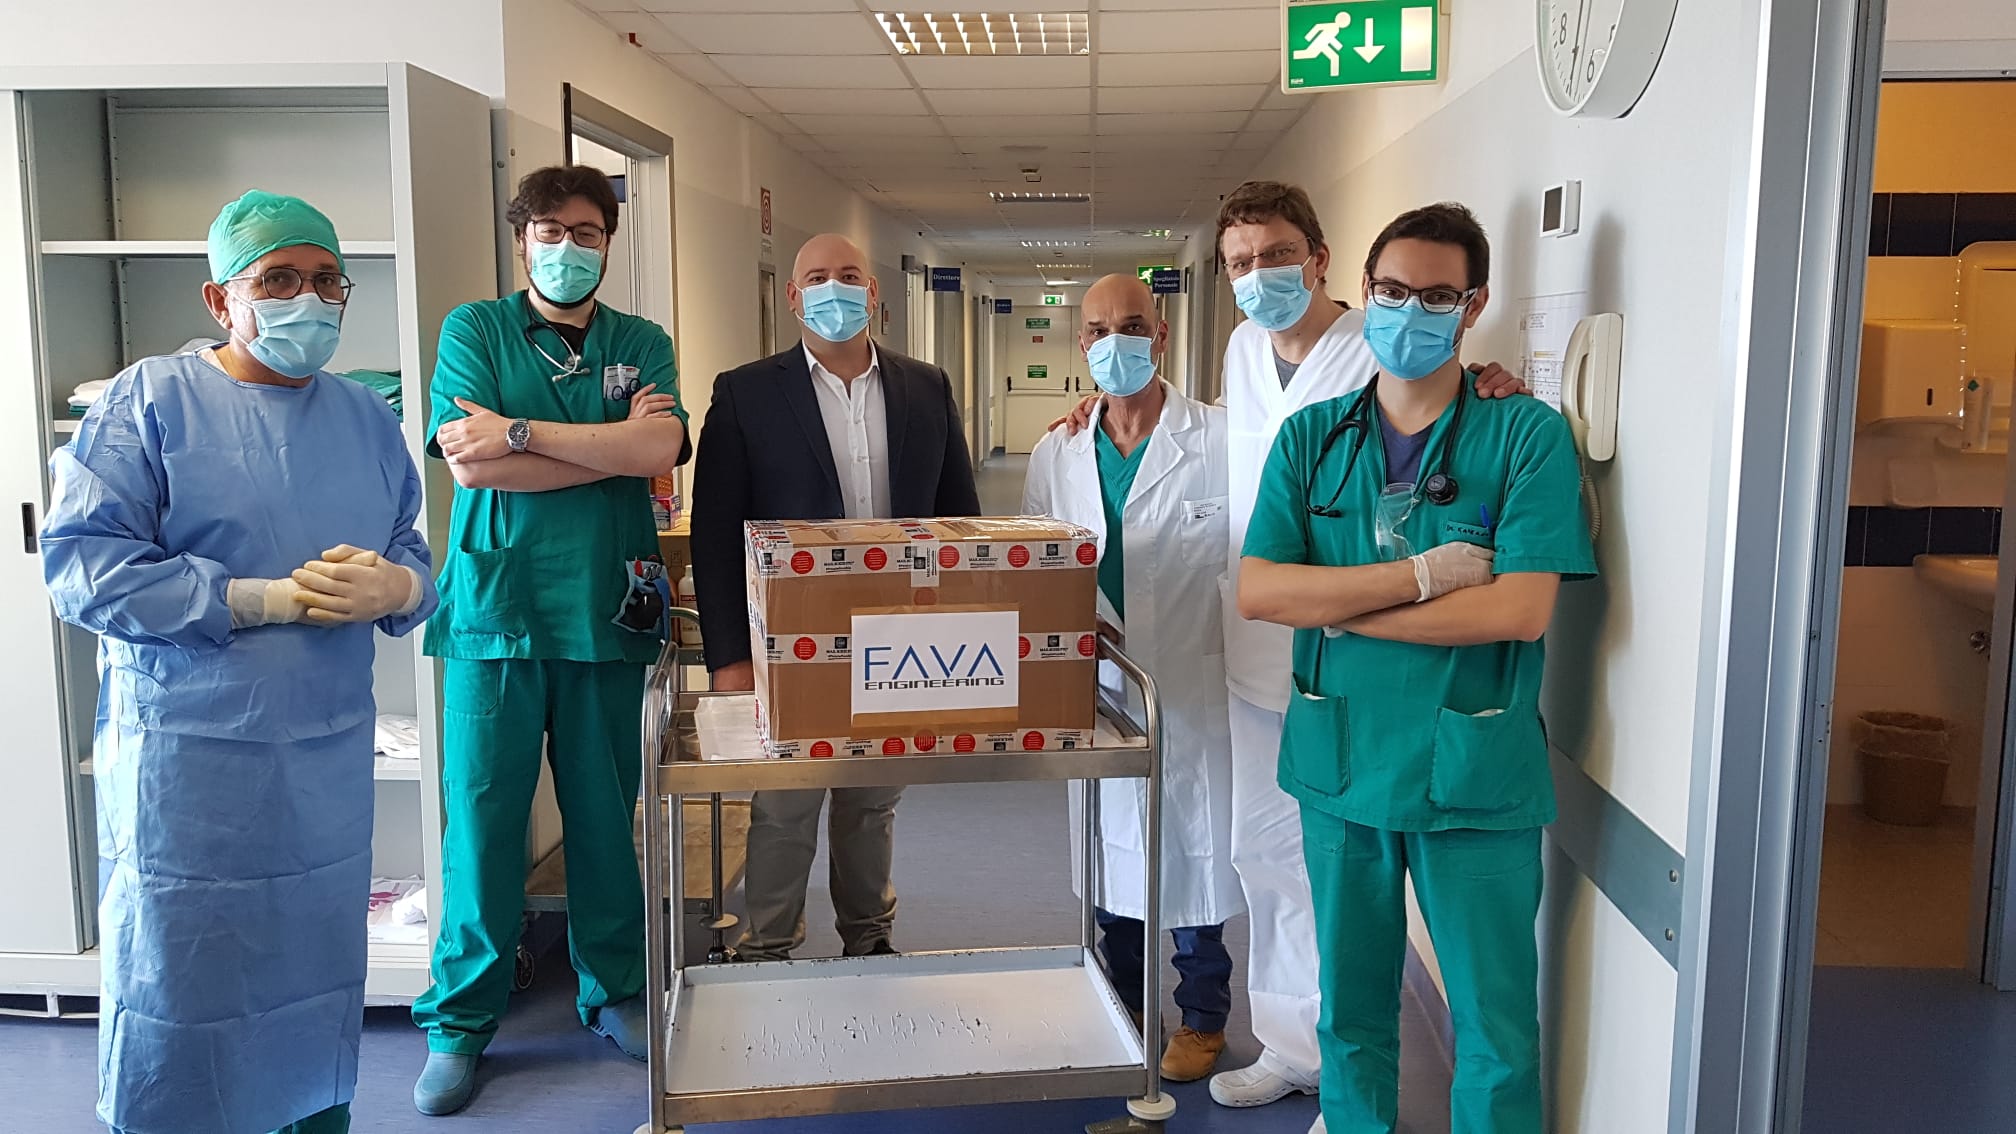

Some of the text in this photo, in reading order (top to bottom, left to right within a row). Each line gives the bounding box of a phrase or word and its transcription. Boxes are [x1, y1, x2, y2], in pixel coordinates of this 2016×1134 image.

[1560, 12, 1567, 45] 8
[1587, 49, 1595, 83] 6
[864, 642, 1004, 681] FAVA
[864, 677, 1005, 690] ENGINEERING
